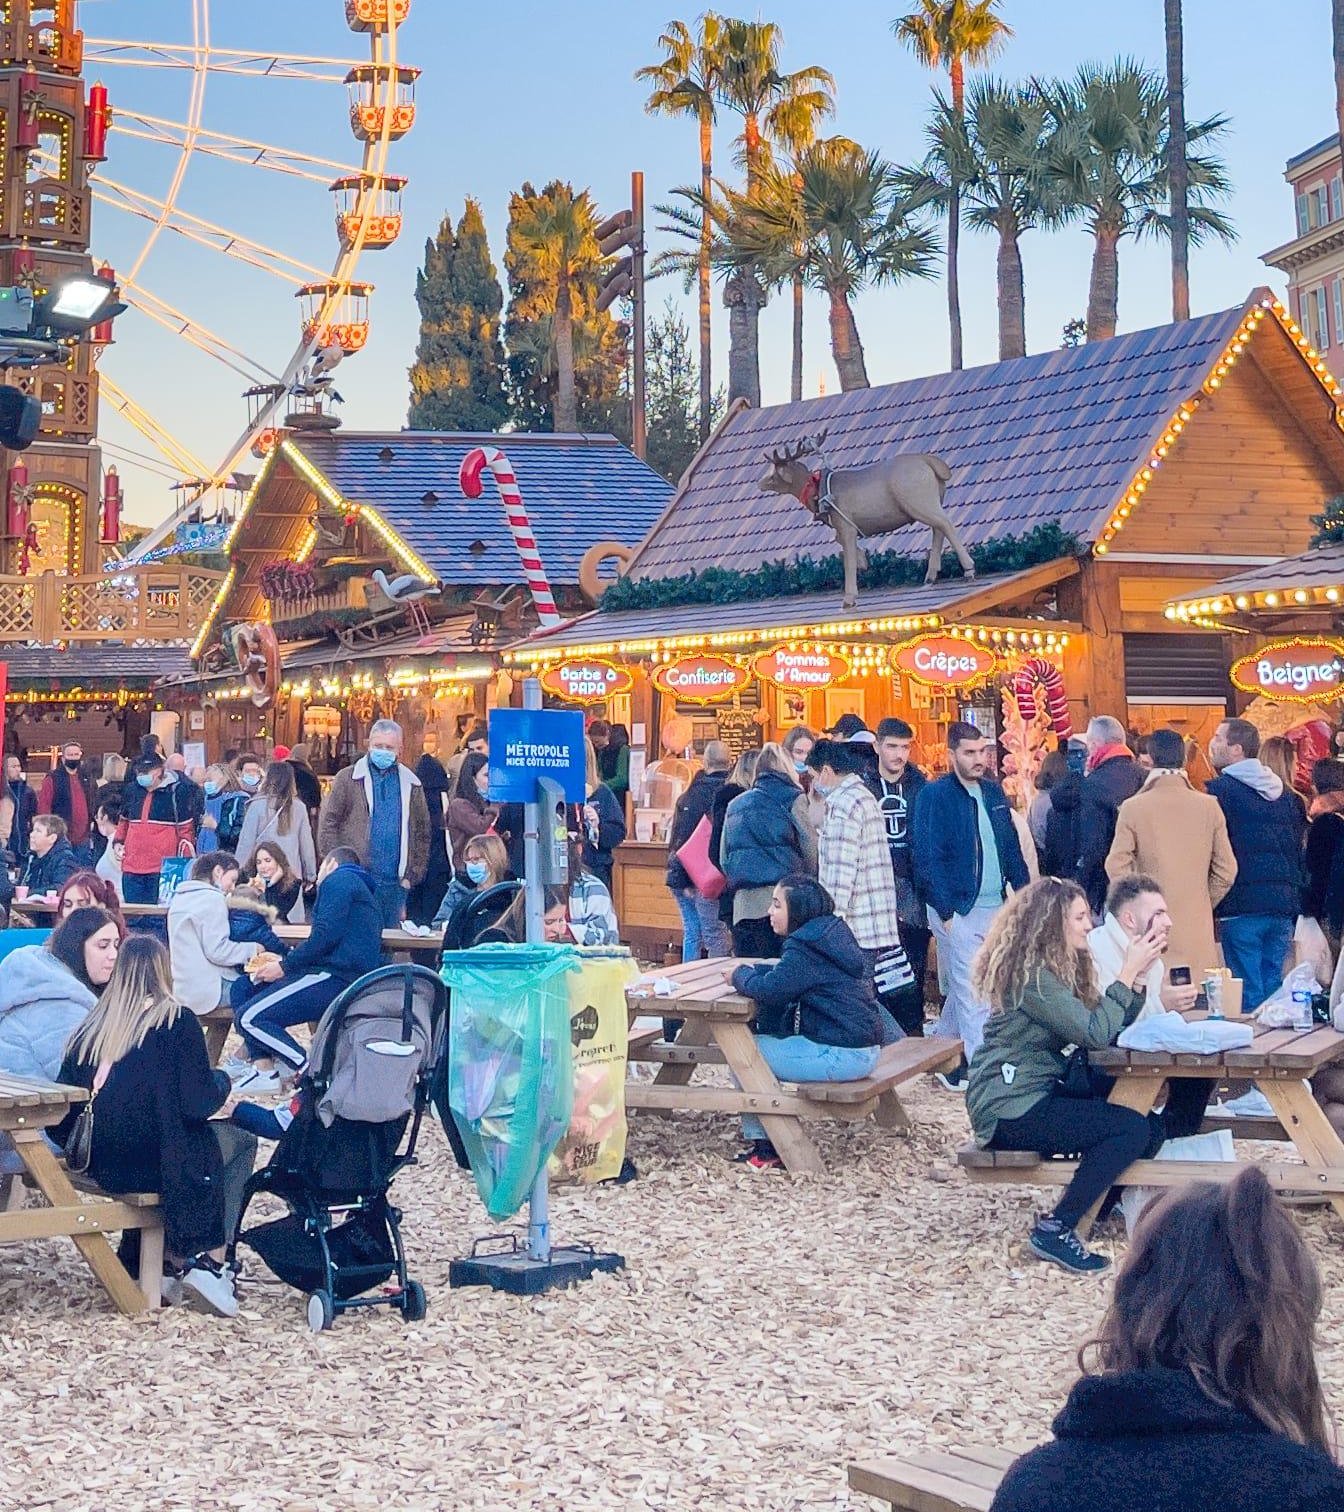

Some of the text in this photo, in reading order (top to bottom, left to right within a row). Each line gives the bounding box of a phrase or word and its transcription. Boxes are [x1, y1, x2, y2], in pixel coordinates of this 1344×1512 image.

[775, 651, 831, 667] Pommes
[914, 647, 979, 677] Crêpes
[559, 667, 602, 681] Barbe
[665, 666, 736, 686] Confiserie
[568, 681, 606, 695] PAPA
[505, 740, 570, 758] MÉTROPOLE
[505, 754, 570, 768] NICE CÔTE D'AZUR
